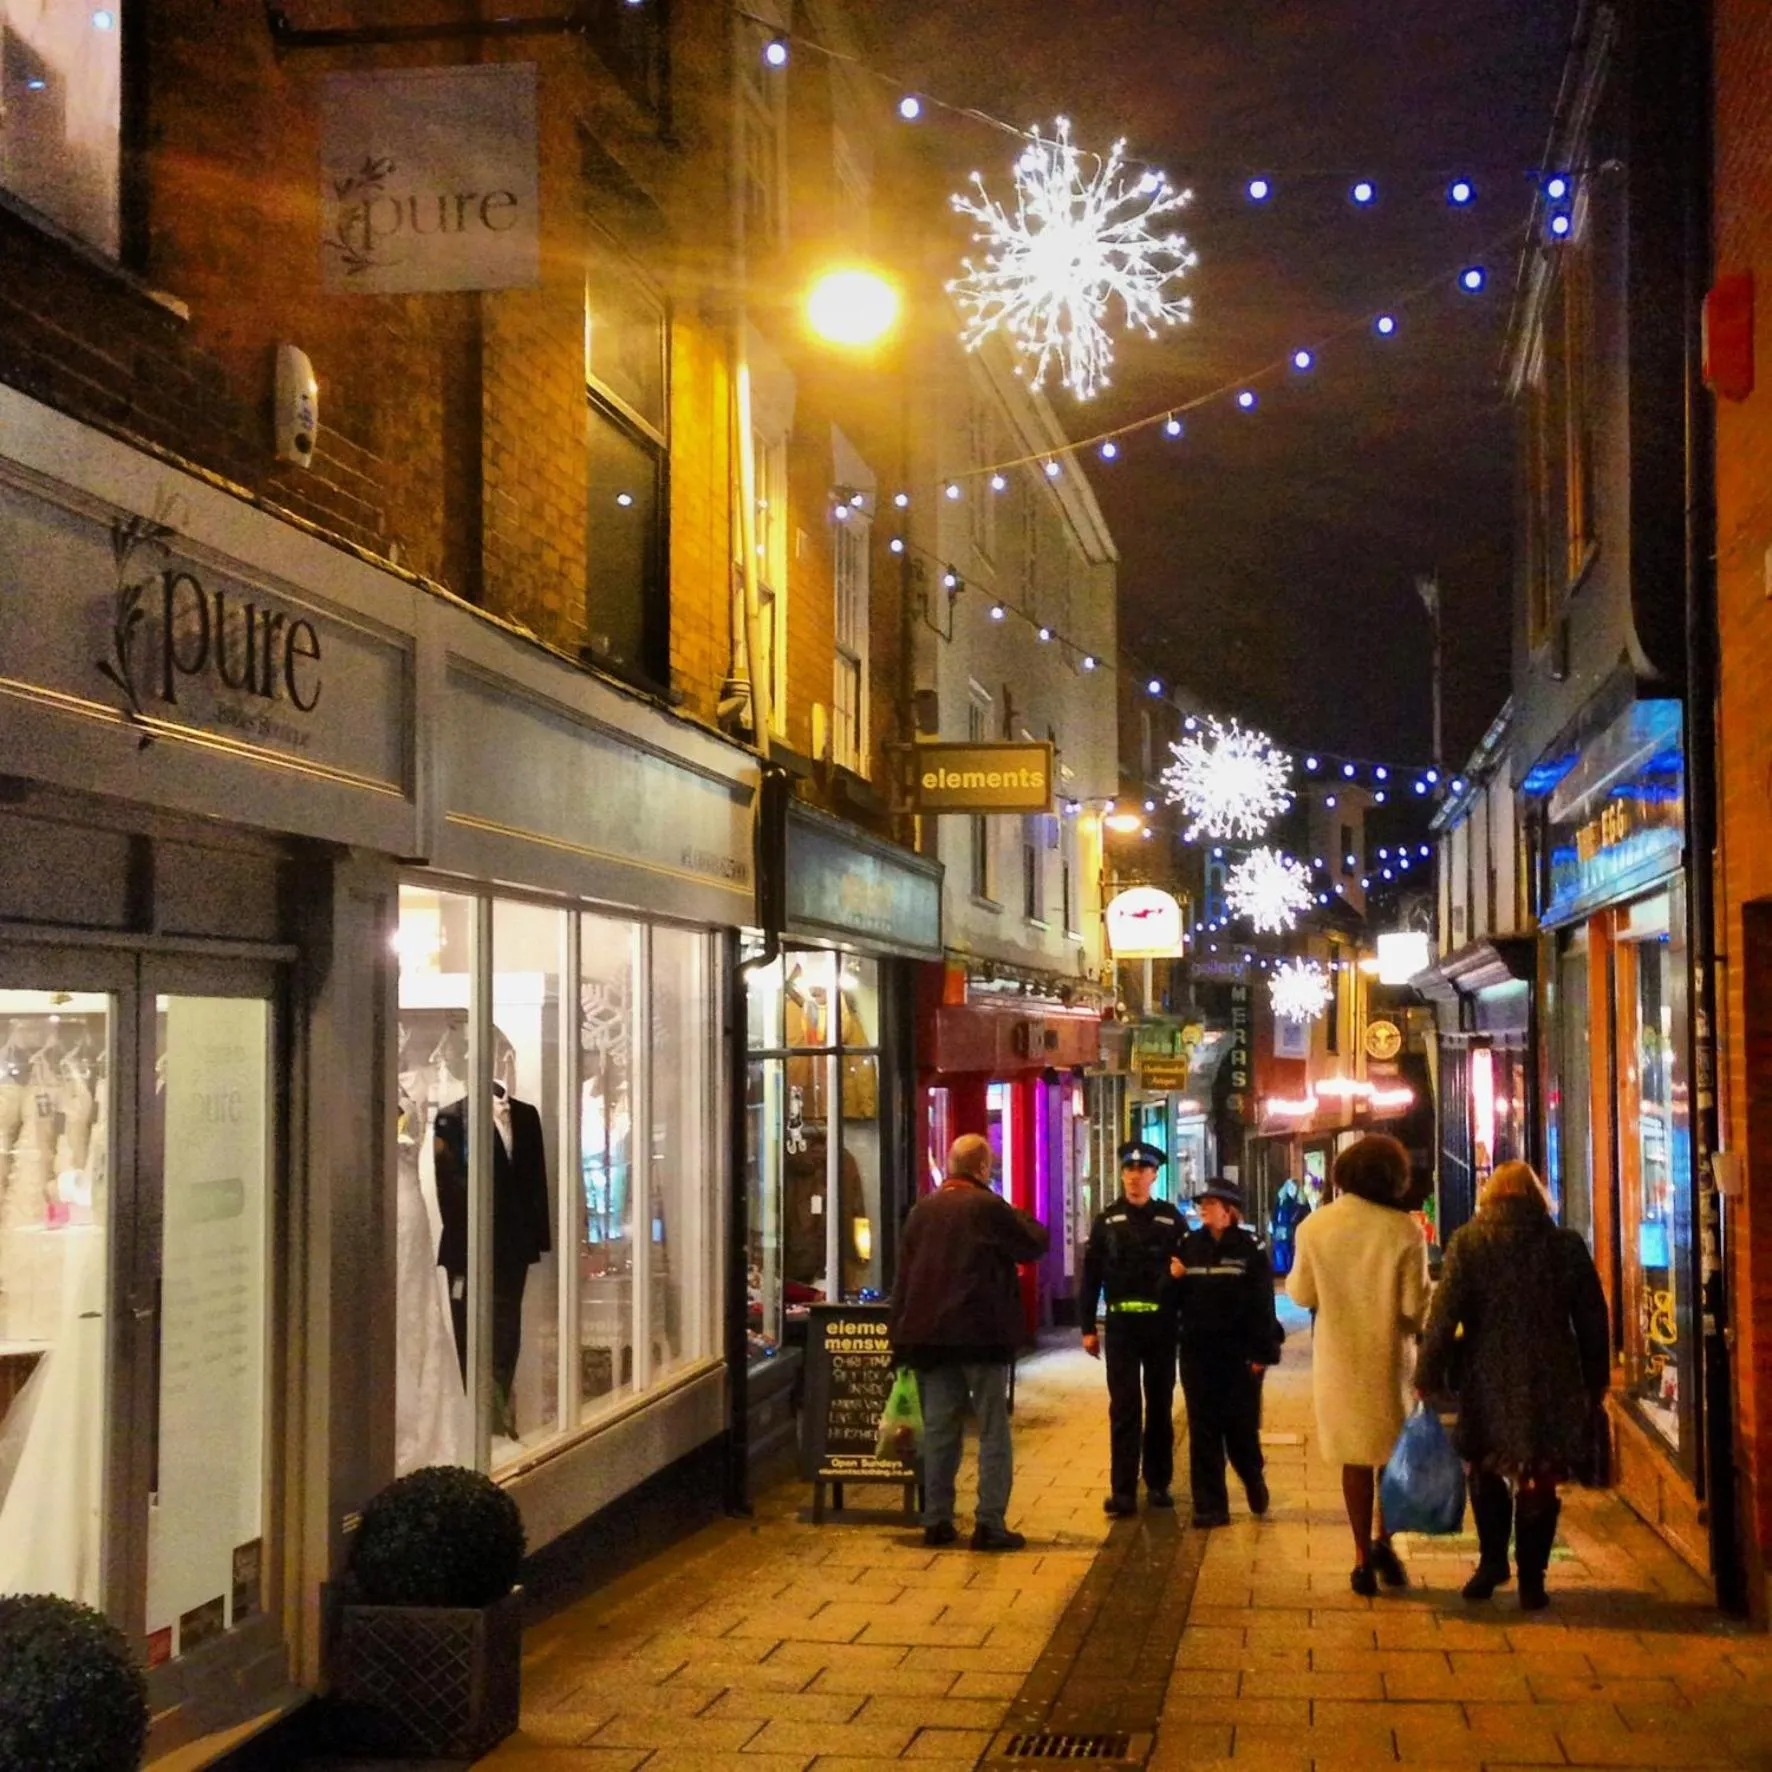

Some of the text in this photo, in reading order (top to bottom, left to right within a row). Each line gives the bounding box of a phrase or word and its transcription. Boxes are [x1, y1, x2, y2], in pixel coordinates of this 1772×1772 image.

[362, 190, 518, 251] pure
[161, 568, 322, 713] pure
[922, 767, 1046, 789] elements
[831, 1458, 858, 1469] Open
